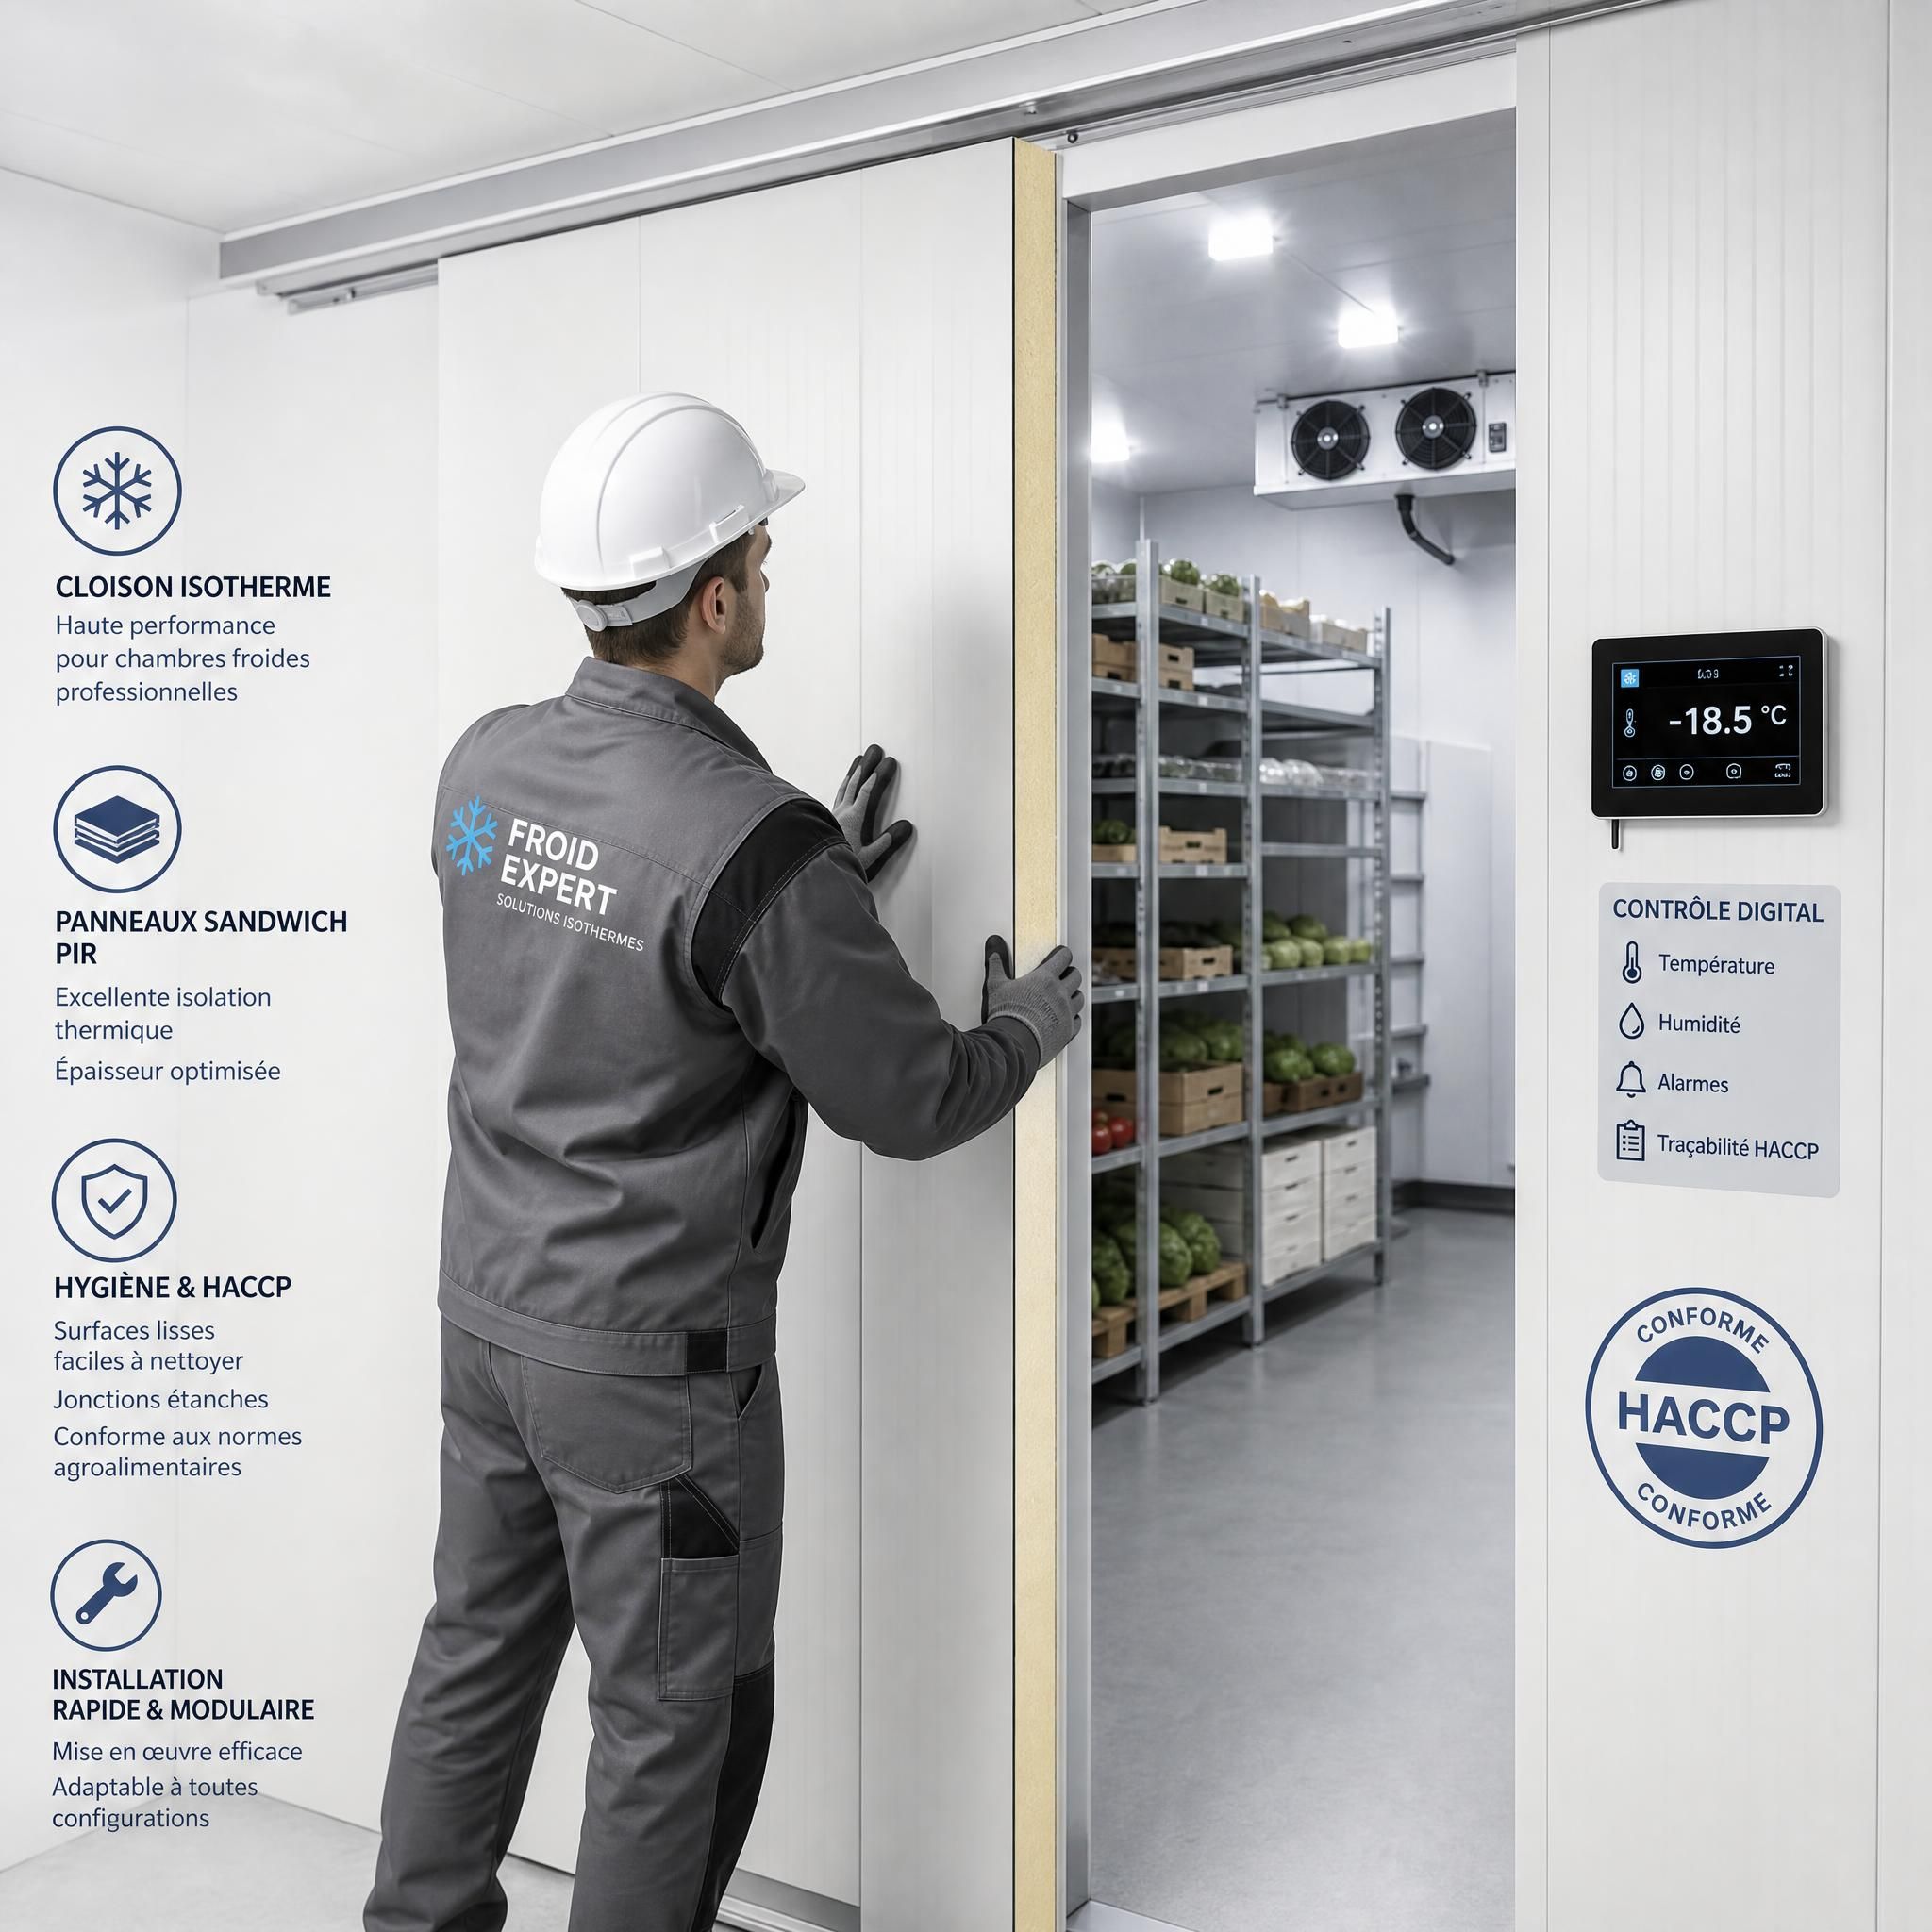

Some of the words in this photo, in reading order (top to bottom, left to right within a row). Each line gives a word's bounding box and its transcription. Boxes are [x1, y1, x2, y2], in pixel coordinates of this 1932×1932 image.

[1669, 706, 1752, 735] -18.5
[1761, 705, 1787, 725] °C
[508, 818, 599, 871] FROID
[501, 854, 617, 915] EXPERT
[496, 893, 560, 924] SOLUTIONS
[563, 915, 644, 952] ISOTHERMES
[1613, 896, 1731, 921] CONTRÔLE
[1738, 901, 1824, 923] DIGITAL
[1658, 954, 1775, 976] Température
[1658, 1014, 1740, 1034] Humidité
[1657, 1074, 1729, 1093] Alarmes
[1657, 1134, 1749, 1158] Traçabilité
[1755, 1140, 1820, 1160] HACCP
[1637, 1307, 1770, 1354] CONFORME
[1618, 1391, 1790, 1445] HACCP
[1637, 1482, 1772, 1530] CONFORME
